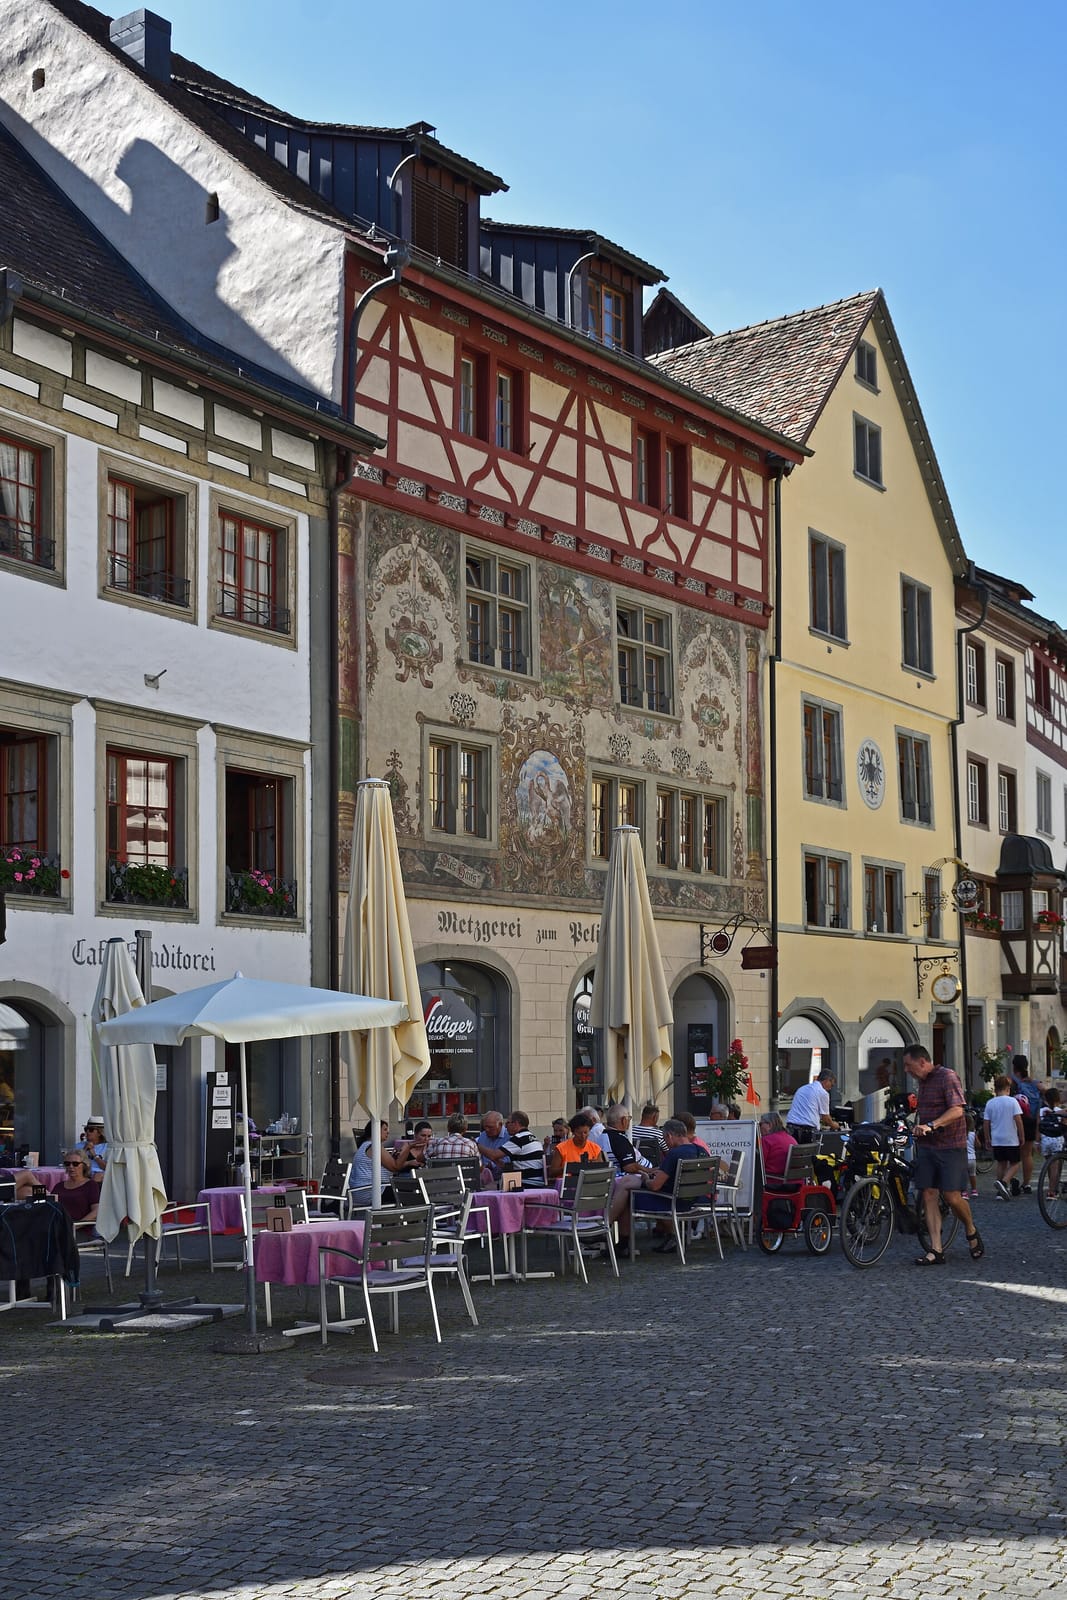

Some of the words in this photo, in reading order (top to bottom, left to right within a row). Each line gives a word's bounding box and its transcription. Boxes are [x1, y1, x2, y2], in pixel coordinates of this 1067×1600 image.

[437, 911, 522, 943] Metzgerei
[535, 928, 557, 944] zum
[569, 921, 600, 947] Peli
[72, 939, 106, 966] Caf
